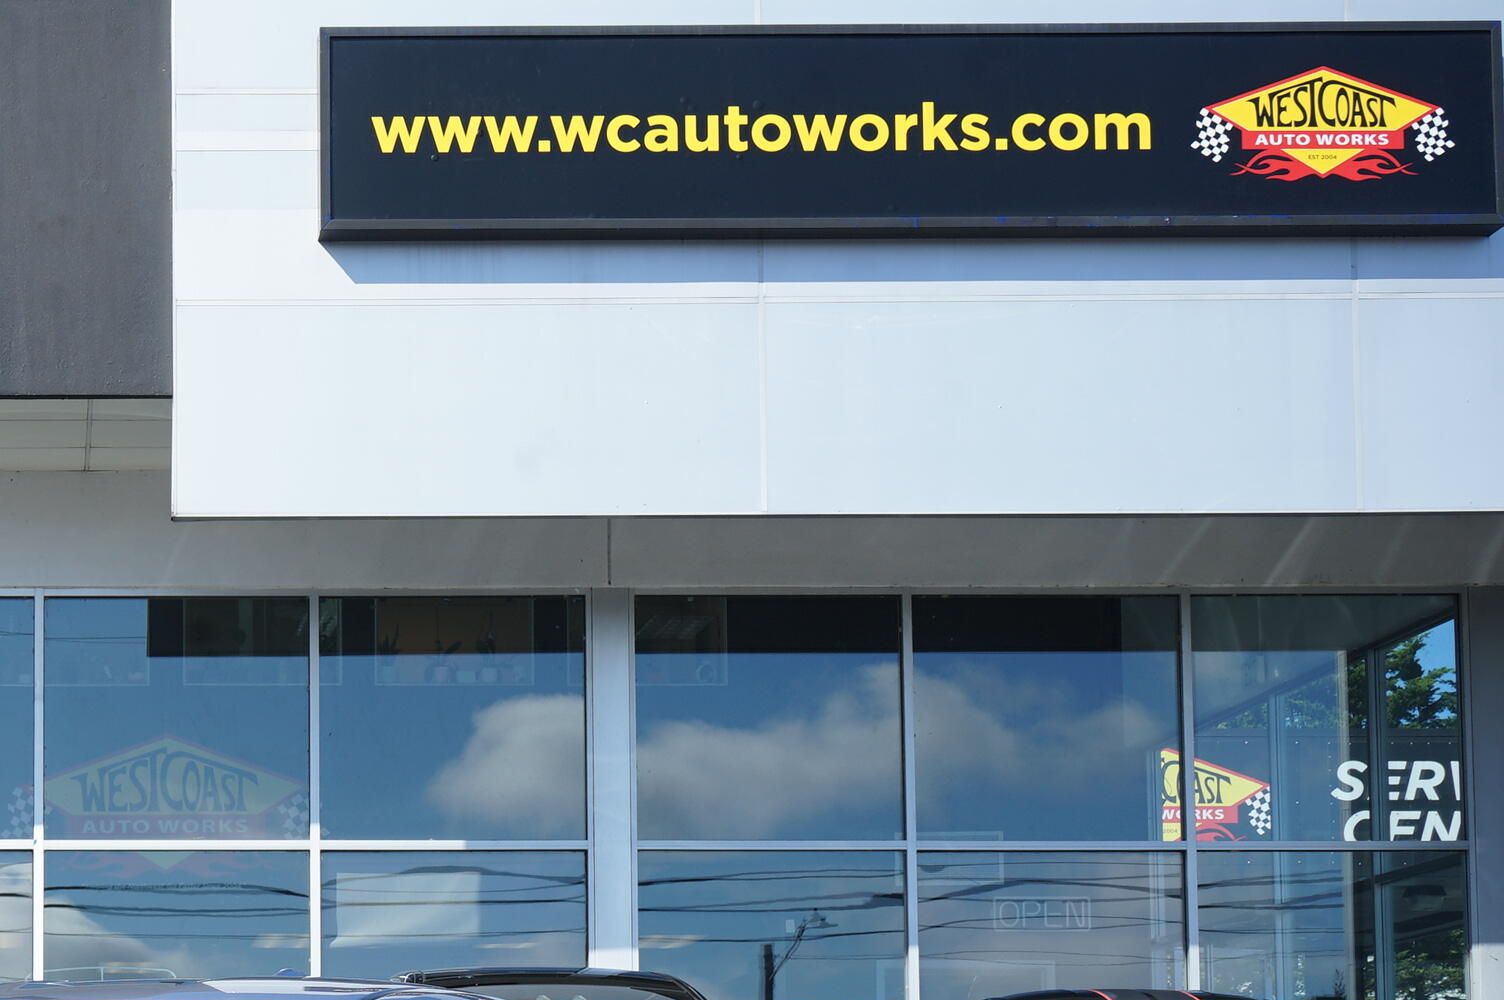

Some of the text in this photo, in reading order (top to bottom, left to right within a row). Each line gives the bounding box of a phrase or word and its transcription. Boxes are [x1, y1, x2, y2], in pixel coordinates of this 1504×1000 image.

[371, 102, 1152, 153] www.wcautoworks.com
[1255, 133, 1390, 145] AUTO WORKS
[81, 819, 249, 834] AUTO WORKS
[999, 900, 1086, 928] OPEN
